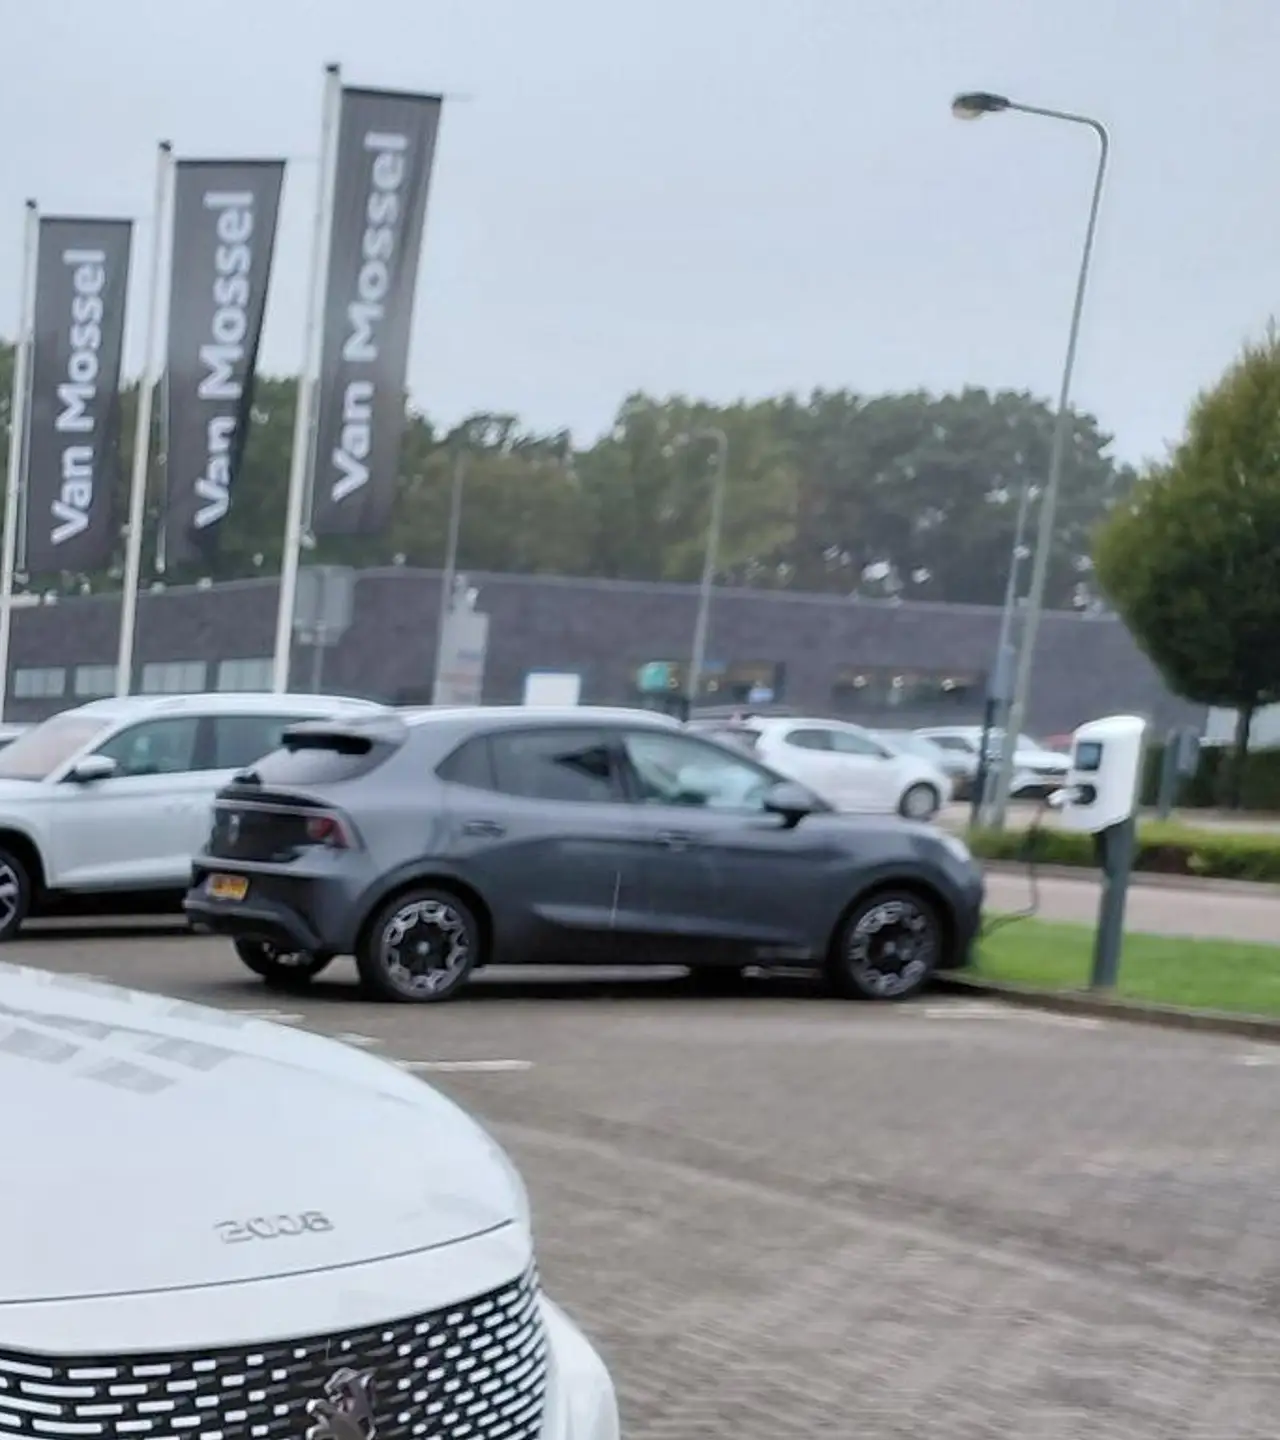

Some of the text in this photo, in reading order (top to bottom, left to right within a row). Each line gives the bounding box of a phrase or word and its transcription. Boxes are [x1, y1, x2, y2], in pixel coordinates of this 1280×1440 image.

[51, 248, 106, 545] Van Mossel
[194, 191, 254, 529] Van Mossel
[332, 131, 409, 501] Van Mossel
[214, 1210, 335, 1244] 2008
